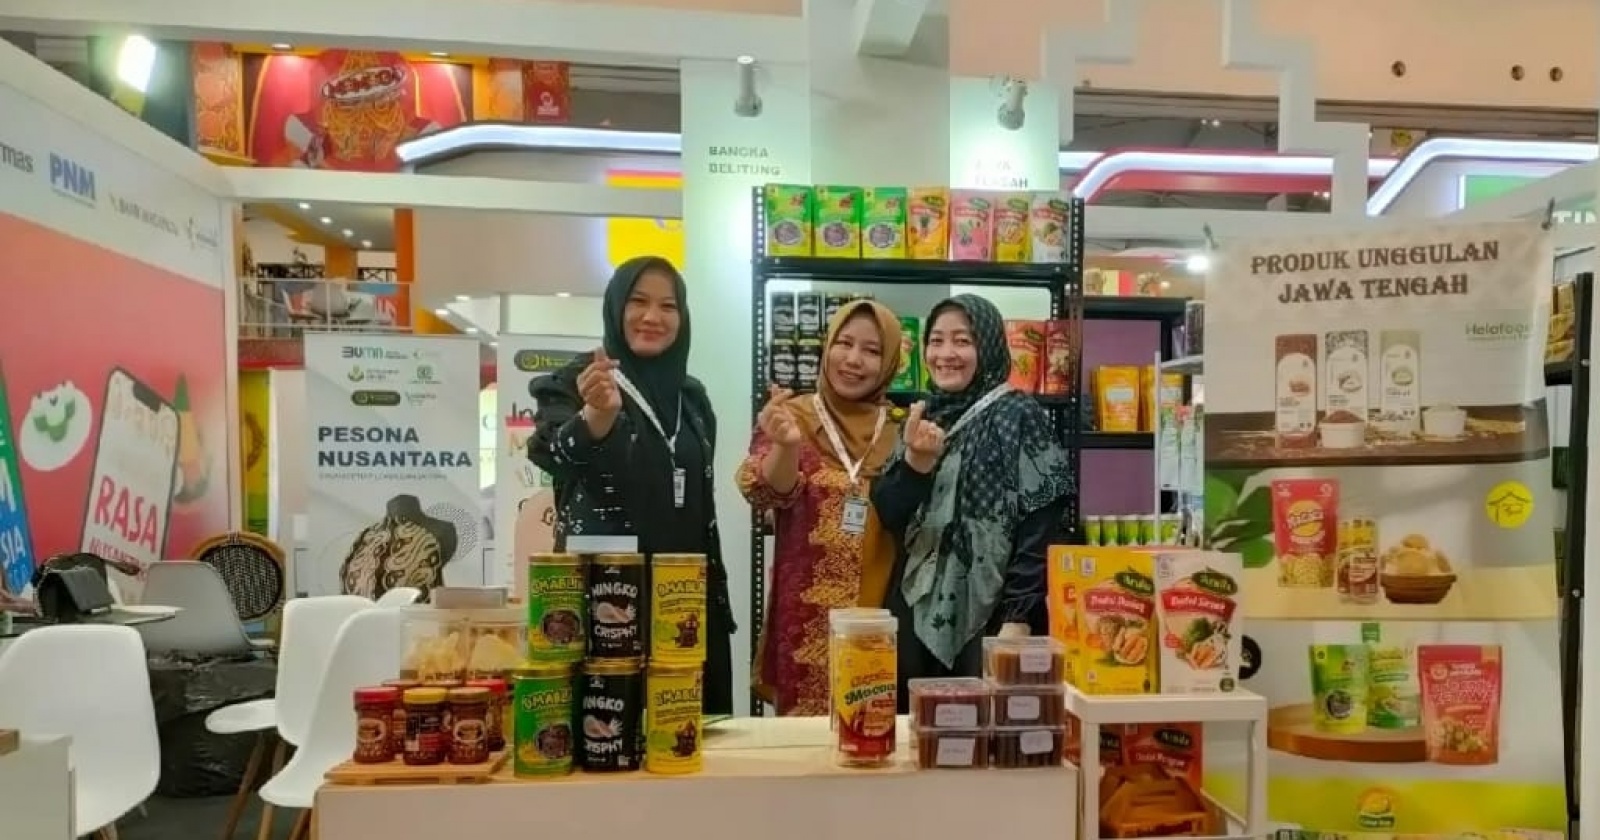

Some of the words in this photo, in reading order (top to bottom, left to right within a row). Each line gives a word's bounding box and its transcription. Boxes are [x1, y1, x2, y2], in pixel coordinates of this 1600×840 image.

[49, 152, 96, 200] PNM
[1250, 251, 1350, 275] PRODUK
[1357, 240, 1499, 269] UNGGULAN
[1278, 278, 1353, 304] JAWA
[1360, 273, 1470, 300] TENGAH
[317, 426, 420, 443] PESONA
[317, 450, 473, 468] NUSANTARA
[94, 475, 158, 554] RASA
